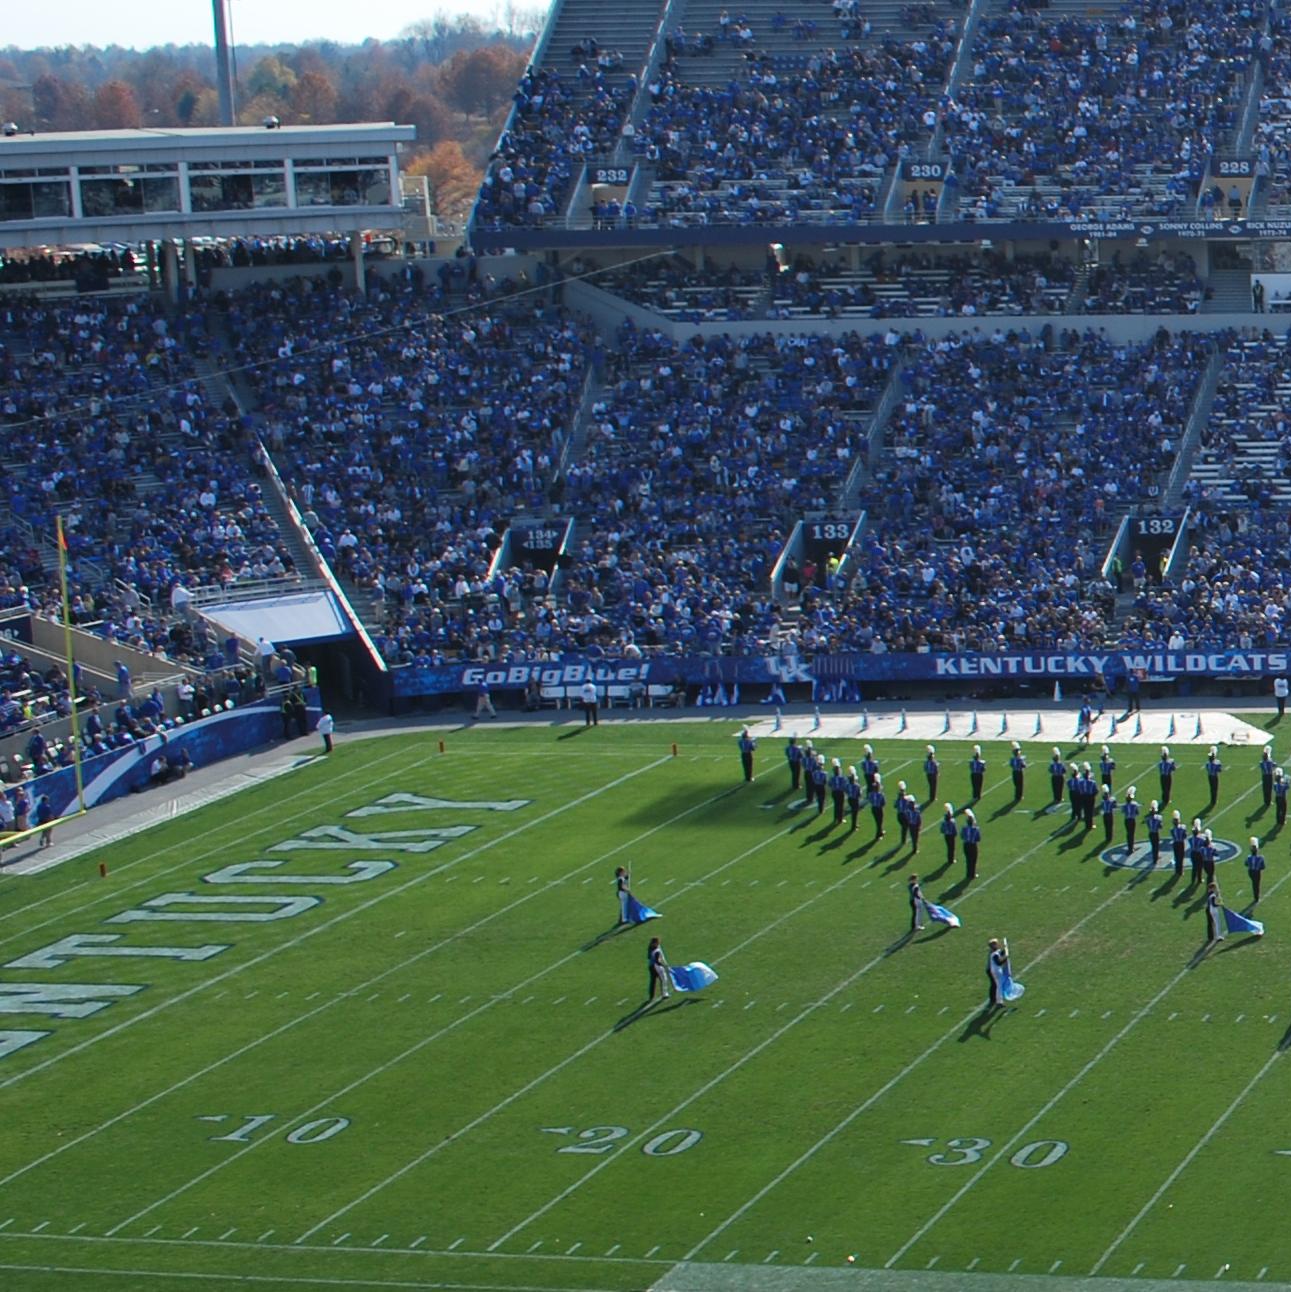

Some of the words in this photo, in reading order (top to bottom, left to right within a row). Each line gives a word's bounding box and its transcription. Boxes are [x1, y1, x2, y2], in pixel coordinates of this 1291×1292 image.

[911, 165, 941, 177] 230
[1220, 162, 1249, 173] 228
[597, 169, 627, 182] 232
[1070, 223, 1104, 231] GEORGE
[1106, 223, 1135, 231] ADAMS
[1159, 223, 1188, 231] SONNY
[1190, 223, 1223, 231] COLLINS
[812, 525, 849, 539] 133
[1138, 520, 1174, 534] 132
[528, 530, 553, 540] 134
[936, 656, 1109, 675] KENTUCKY
[1122, 654, 1288, 672] WILDCATS
[0, 793, 532, 1057] NTUCKY
[207, 1114, 351, 1145] 10
[555, 1125, 703, 1156] 20
[927, 1137, 1070, 1168] 30
